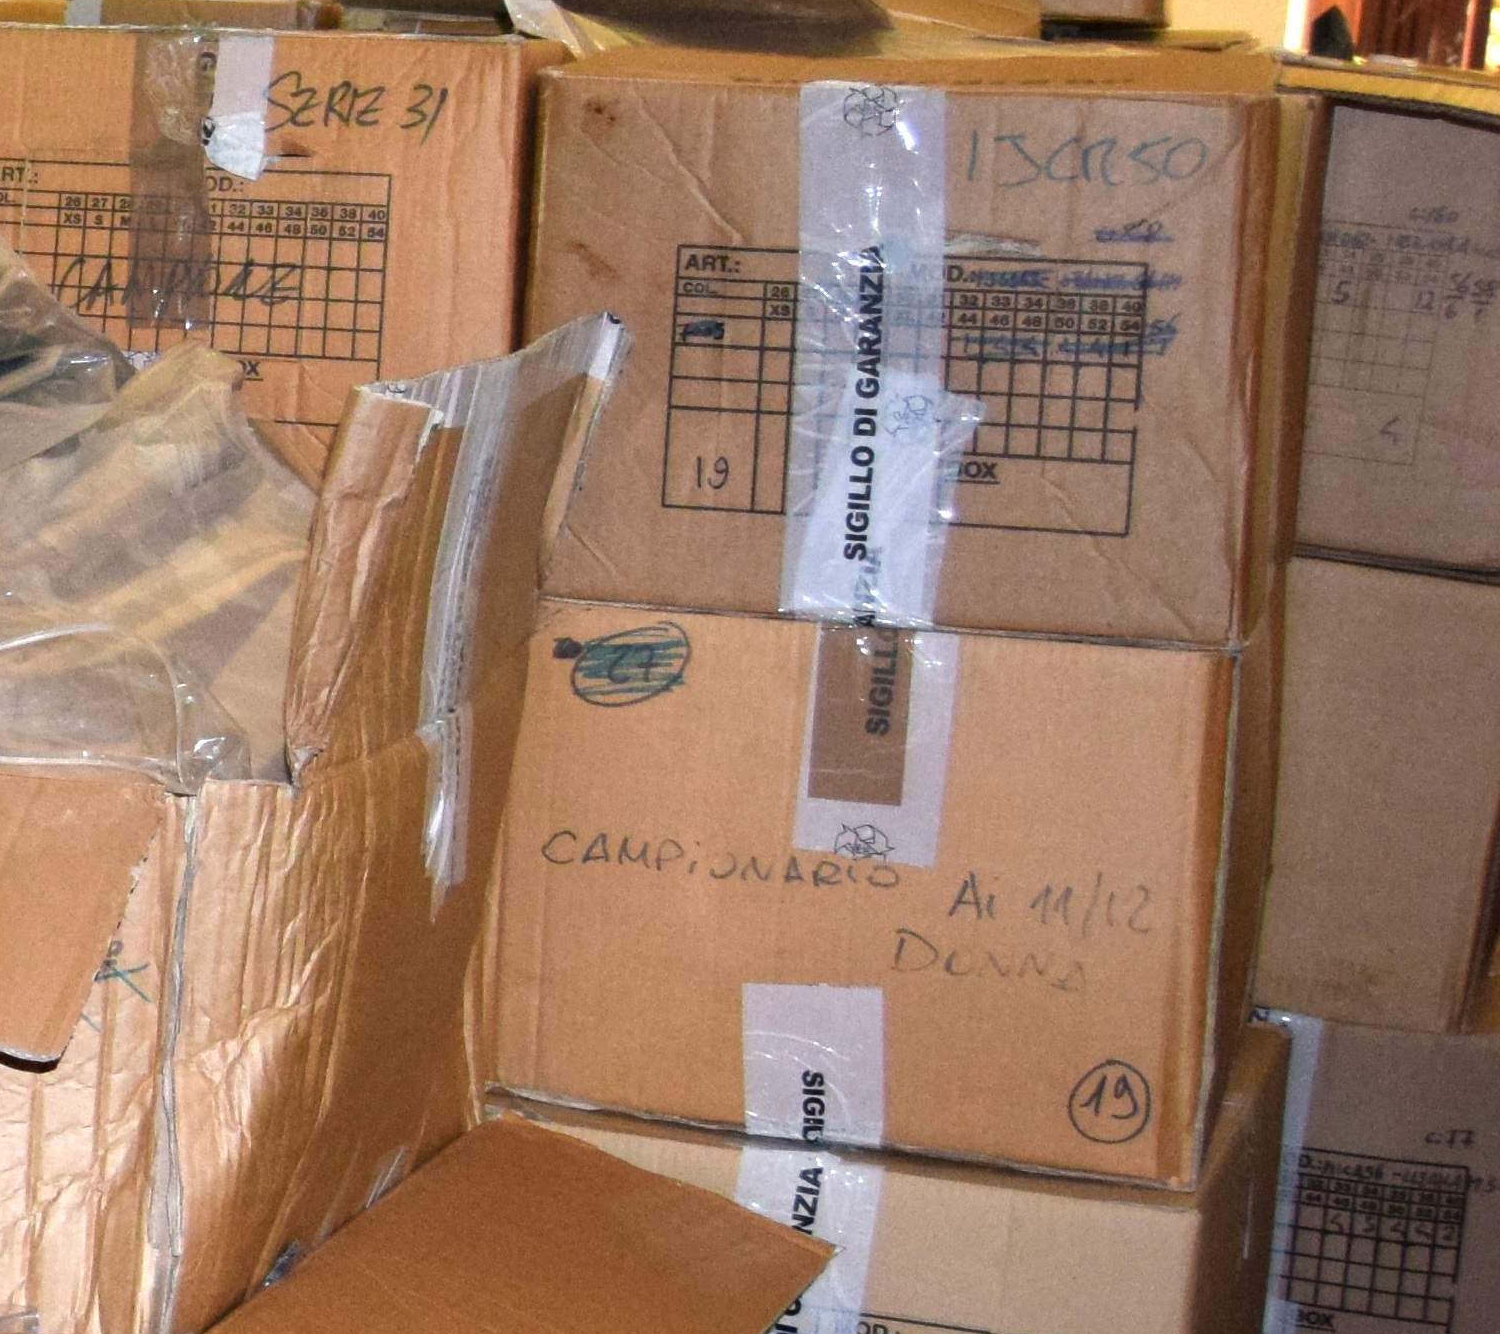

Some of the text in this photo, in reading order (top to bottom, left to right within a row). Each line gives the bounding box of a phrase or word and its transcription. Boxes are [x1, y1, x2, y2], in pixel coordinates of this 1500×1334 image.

[400, 84, 449, 146] 31
[842, 242, 884, 562] SIGILLO DI GARANZIA
[694, 455, 730, 490] 19
[1080, 1073, 1142, 1120] 19
